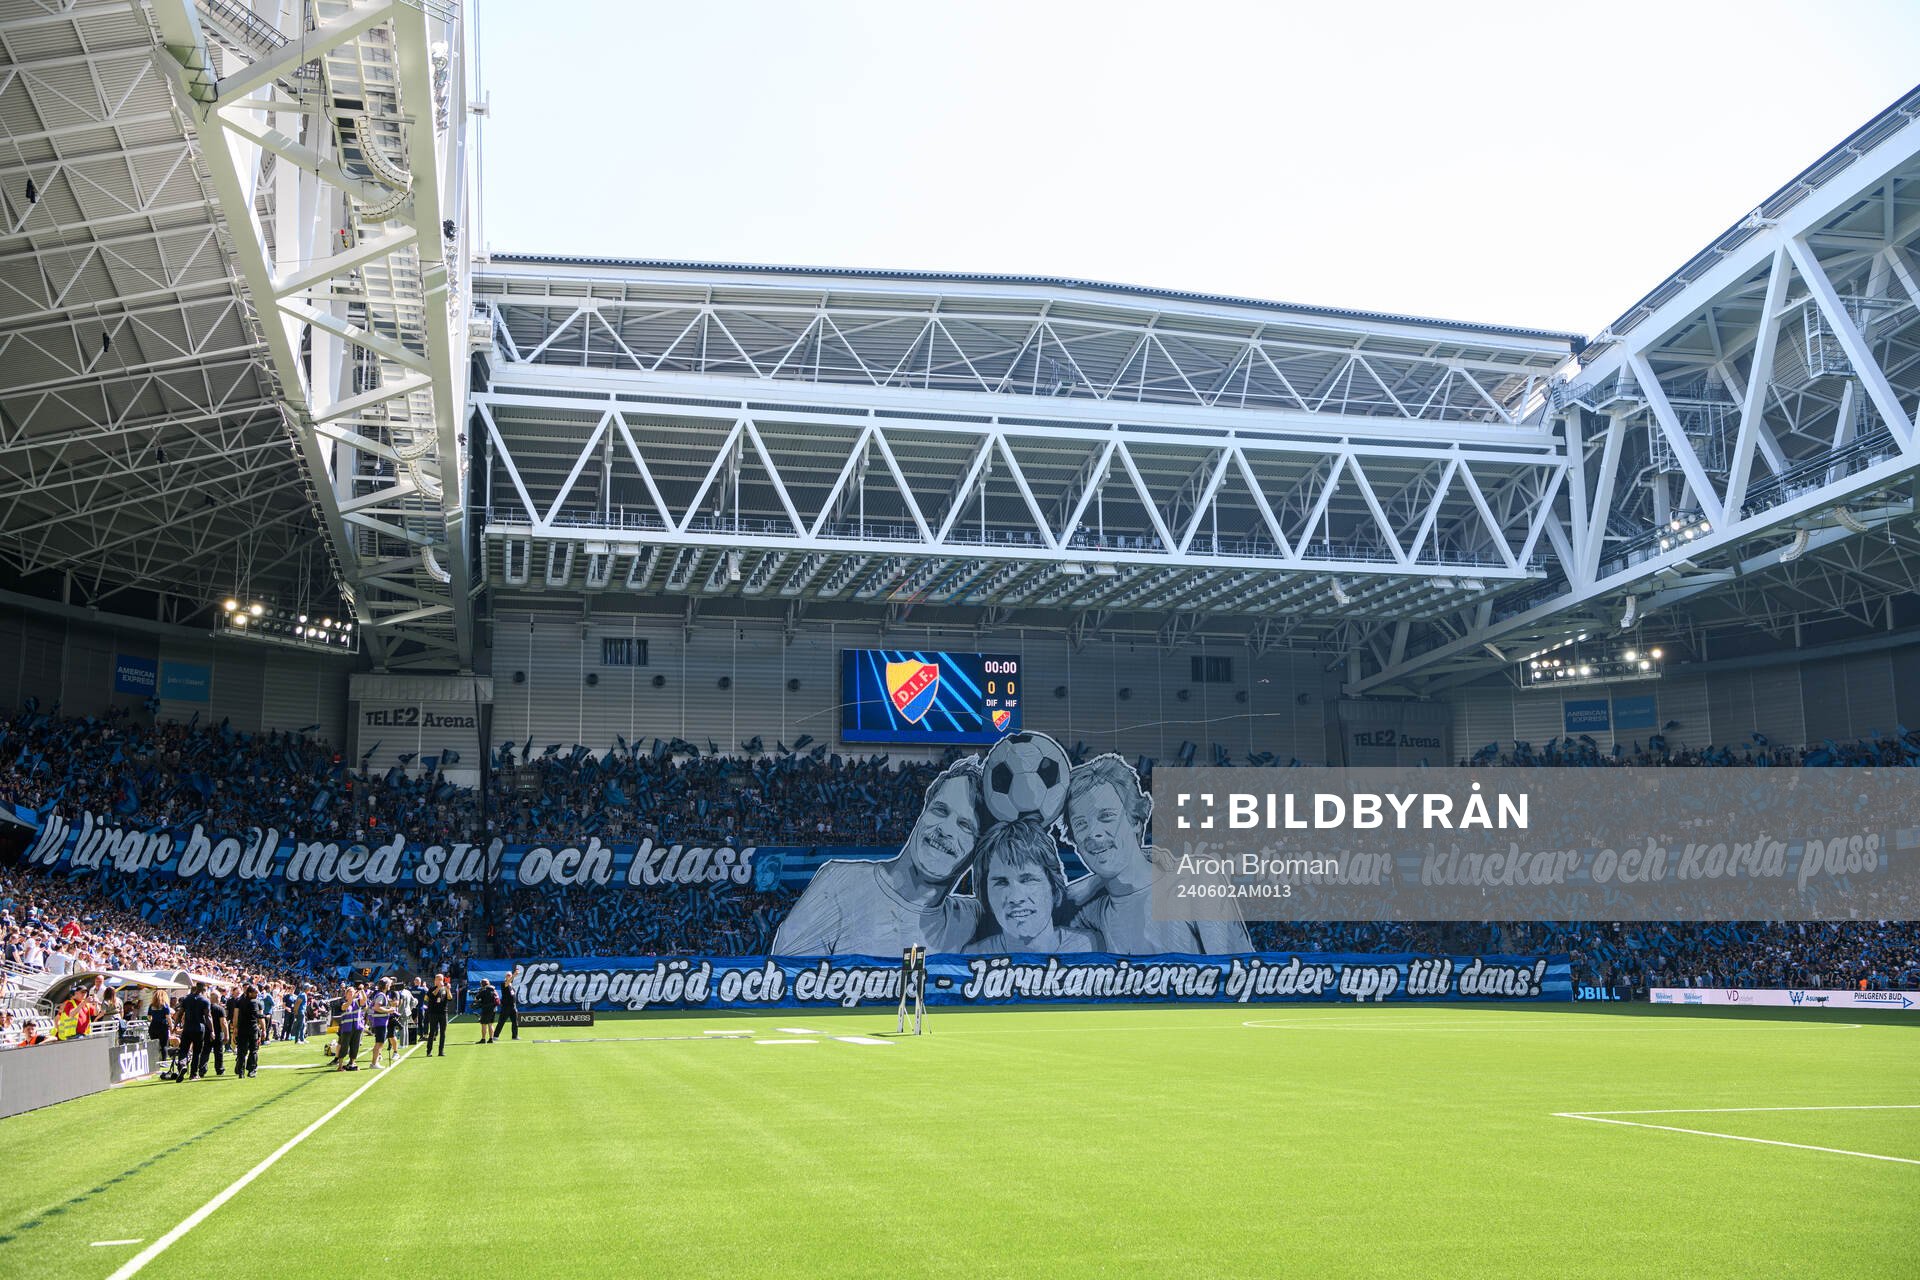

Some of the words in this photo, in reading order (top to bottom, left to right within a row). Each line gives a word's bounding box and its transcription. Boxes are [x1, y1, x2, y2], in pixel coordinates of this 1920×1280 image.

[117, 666, 155, 678] AMERICAN
[985, 661, 1017, 674] 00:00
[122, 674, 155, 686] EXPRESS
[987, 681, 996, 695] 0
[1007, 681, 1015, 695] 0
[986, 699, 998, 707] DIF
[1005, 699, 1017, 707] HIF
[365, 707, 419, 727] TELE2
[422, 712, 475, 728] Arena
[1353, 729, 1397, 747] TELE2
[1399, 734, 1441, 748] Arena
[71, 810, 174, 873] lirar
[178, 824, 279, 879] boll
[286, 833, 405, 885] med
[519, 837, 613, 886] och
[628, 838, 757, 885] klass
[1421, 842, 1582, 887] klackar
[1592, 837, 1668, 883] och
[1677, 834, 1787, 880] korta
[1798, 833, 1879, 892] pass
[513, 961, 710, 1011] Kämpaglöd
[720, 960, 785, 1002] och
[964, 958, 1220, 999] Järnkaminerna
[1226, 958, 1335, 1003] bjuder
[1340, 965, 1398, 1002] upp
[1407, 959, 1453, 995] till
[1460, 958, 1546, 996] dans!
[1854, 992, 1887, 1000] PIHLGRENS
